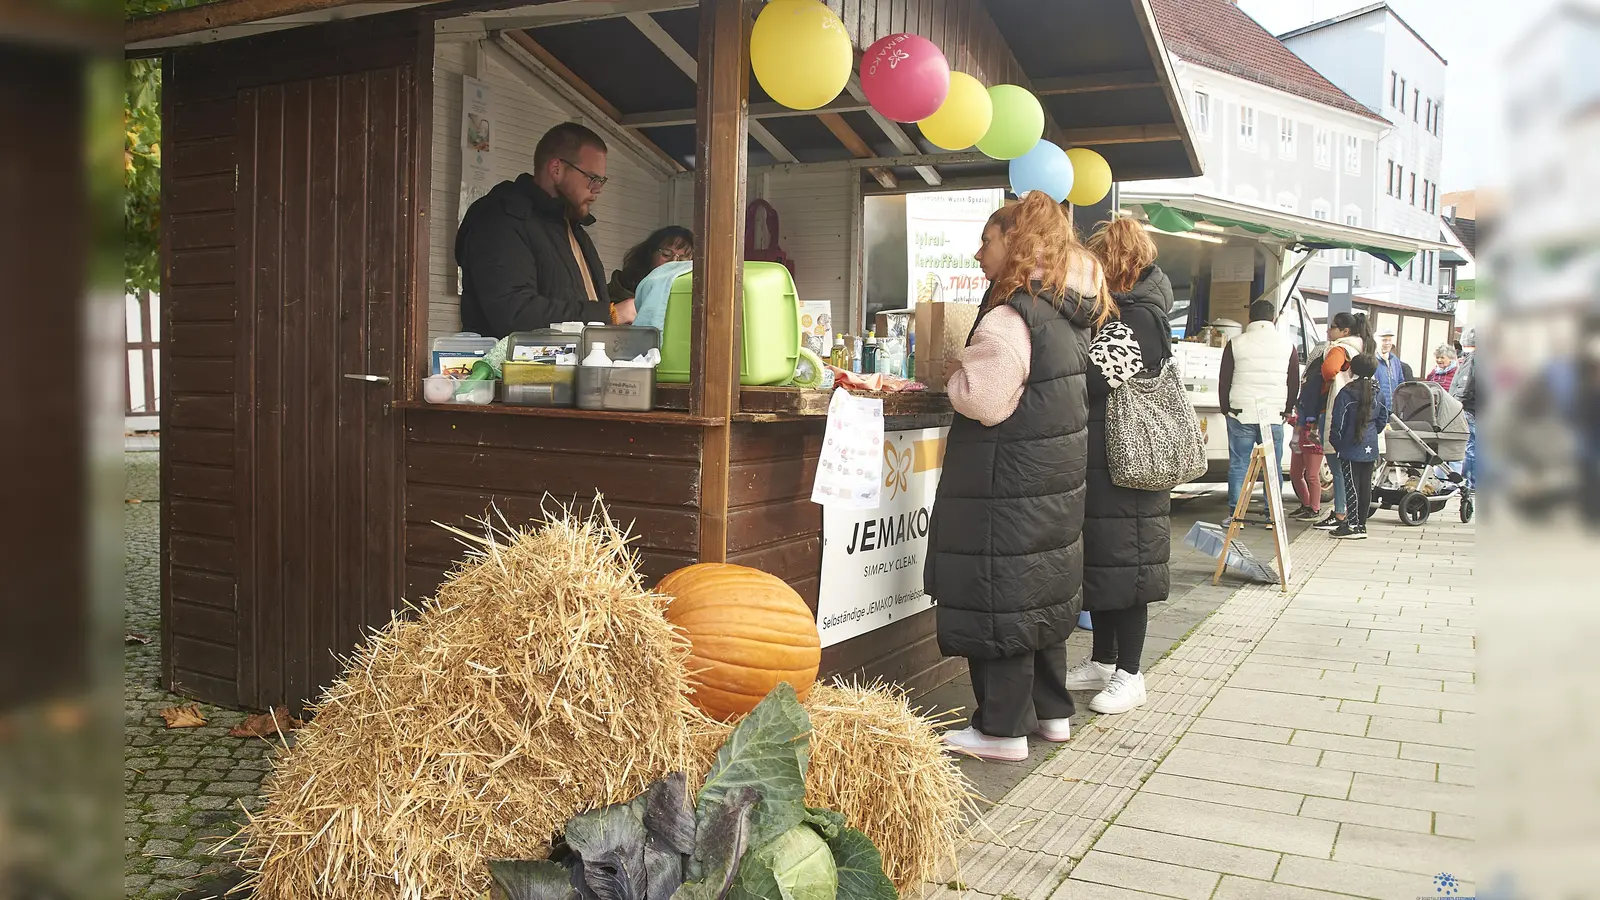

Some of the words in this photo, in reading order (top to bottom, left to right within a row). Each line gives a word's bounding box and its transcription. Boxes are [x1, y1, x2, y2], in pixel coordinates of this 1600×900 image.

[869, 34, 909, 75] JEMAKO
[846, 507, 929, 555] JEMAKO
[863, 560, 895, 578] SIMPLY
[895, 554, 918, 571] CLEAN.
[822, 604, 866, 630] Selbständige
[866, 595, 894, 616] JEMAKO
[894, 588, 926, 605] Vertriebspa
